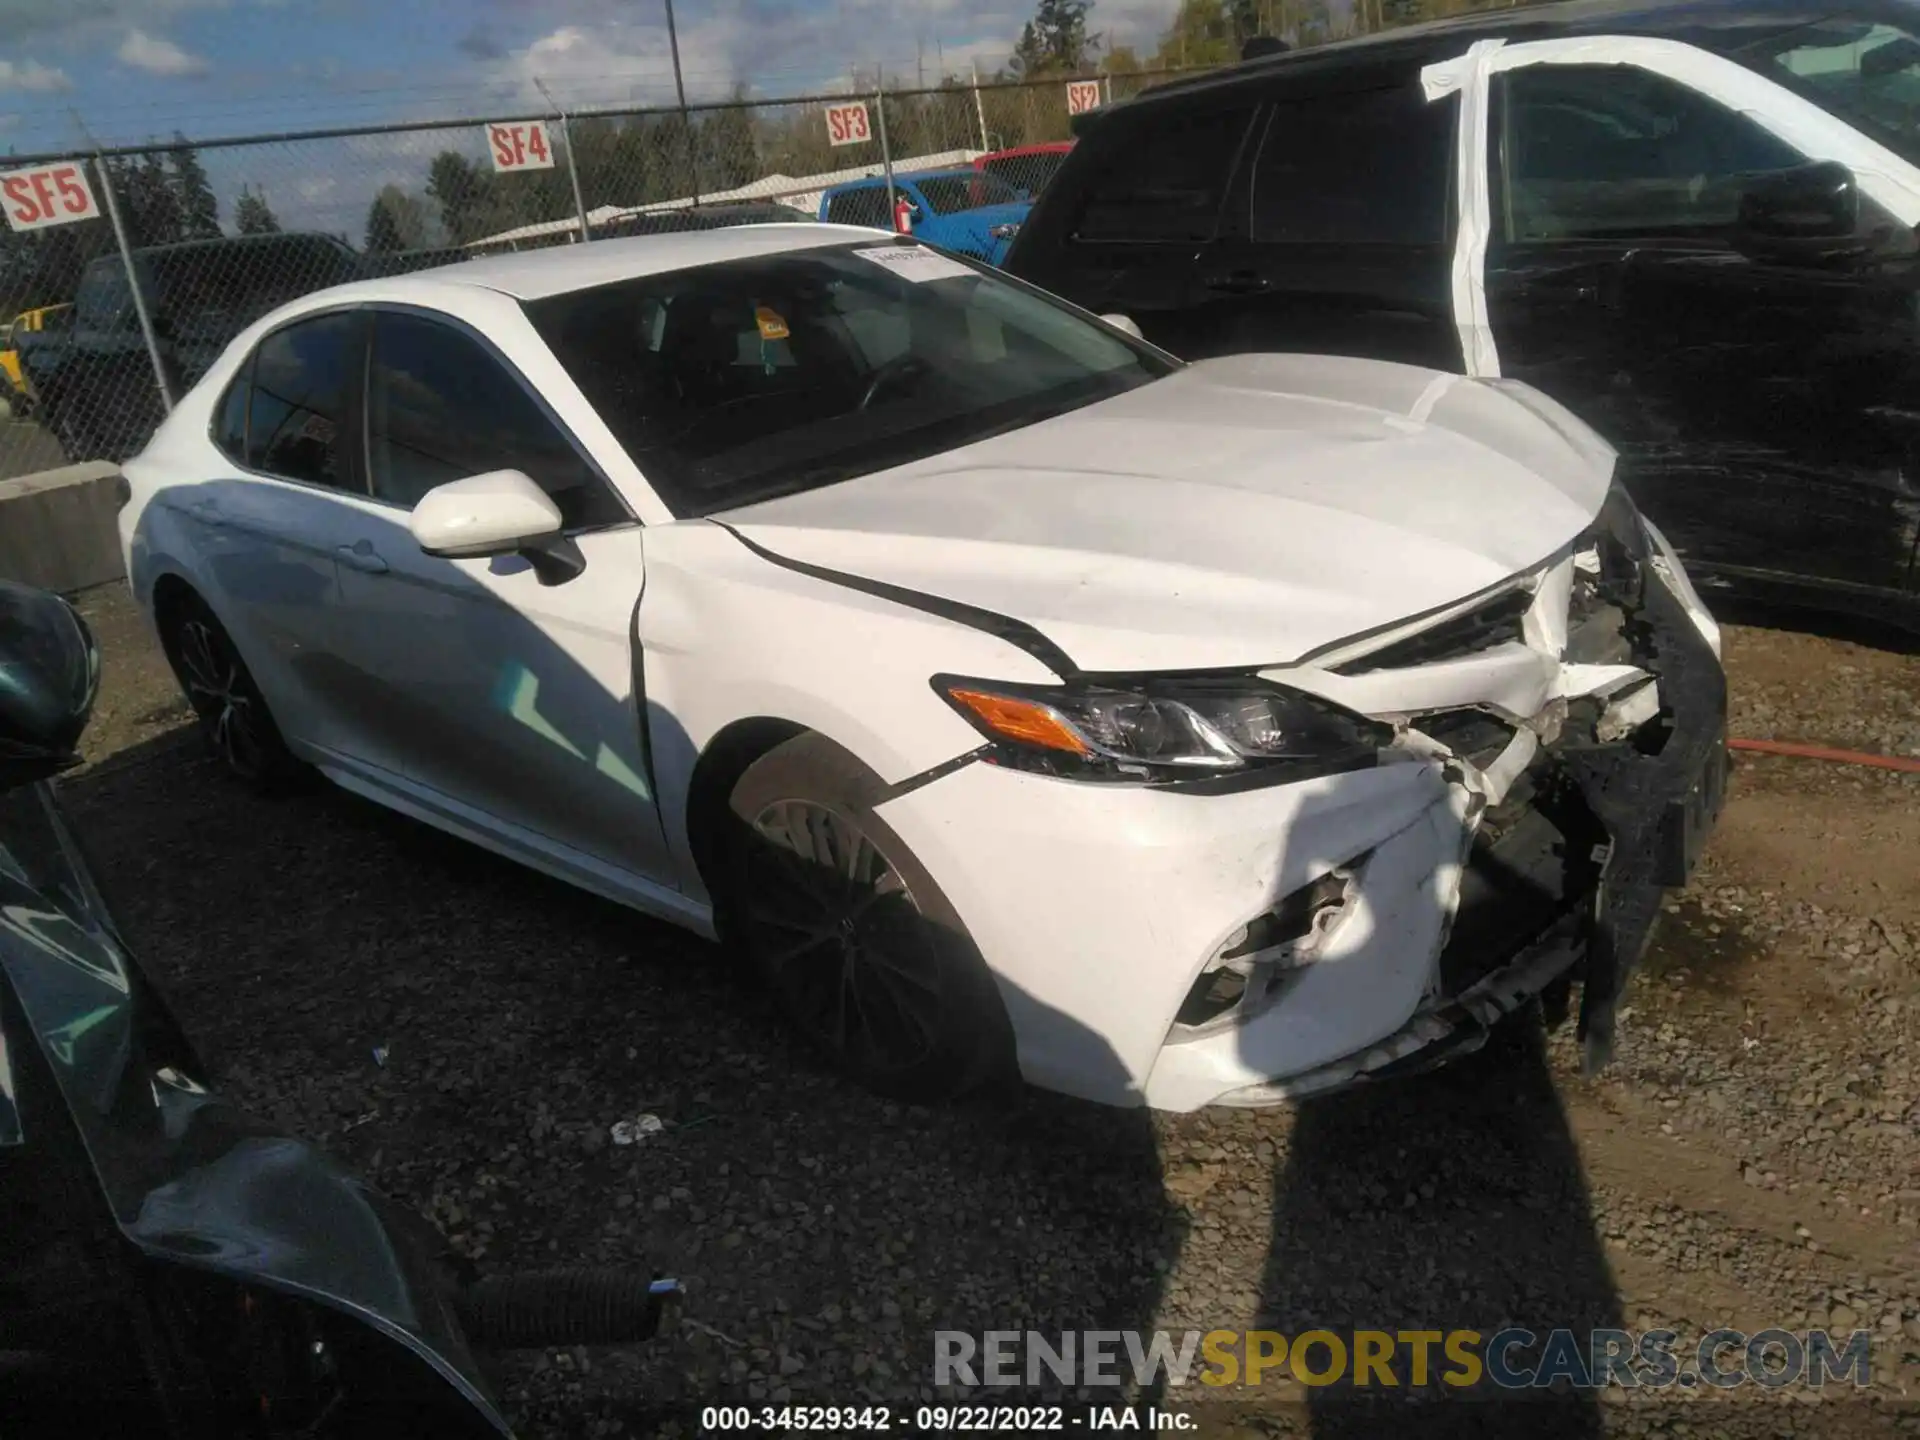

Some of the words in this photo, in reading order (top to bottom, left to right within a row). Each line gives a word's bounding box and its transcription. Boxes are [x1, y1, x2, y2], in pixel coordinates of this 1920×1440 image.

[1070, 84, 1096, 113] SF2
[829, 106, 867, 140] SF3
[492, 126, 546, 165] SF4
[3, 167, 88, 222] SF5
